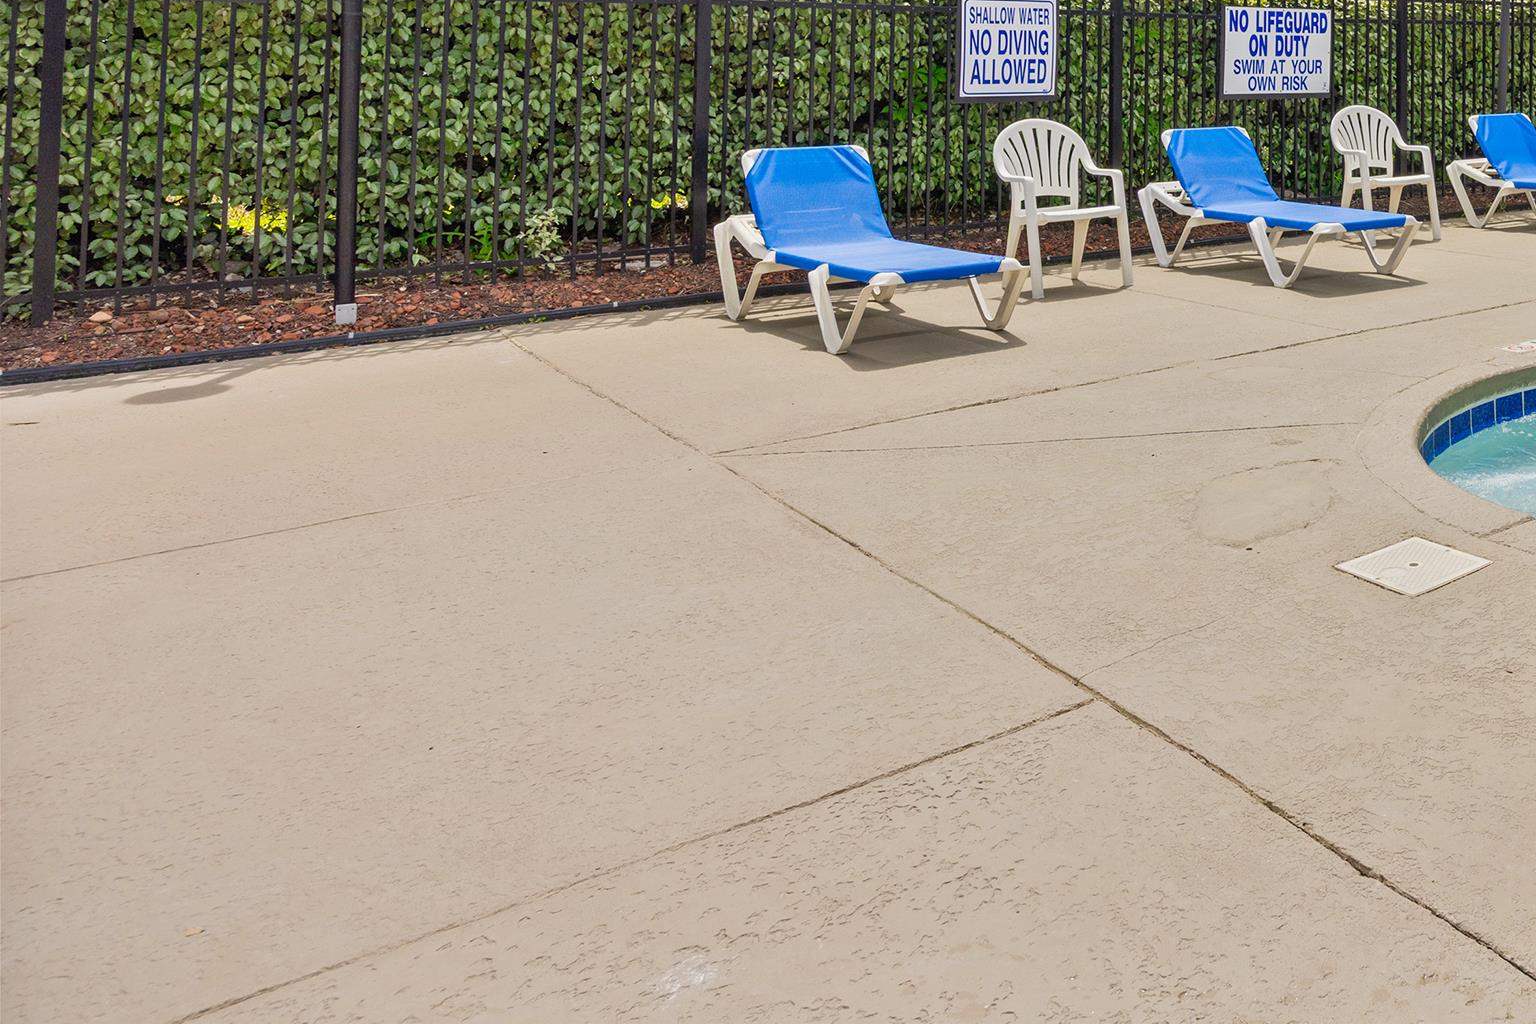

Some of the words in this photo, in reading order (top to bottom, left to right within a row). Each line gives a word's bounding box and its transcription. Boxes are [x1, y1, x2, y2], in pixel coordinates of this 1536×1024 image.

[969, 6, 1016, 24] SHALLOW
[1019, 7, 1050, 25] WATER
[1229, 9, 1249, 32] NO
[1256, 10, 1328, 34] LIFEGUARD
[969, 29, 992, 55] NO
[997, 29, 1049, 55] DIVING
[1248, 34, 1268, 57] ON
[1275, 34, 1310, 57] DUTY
[969, 58, 1047, 85] ALLOWED
[1233, 59, 1265, 75] SWIM
[1270, 59, 1286, 75] AT
[1291, 59, 1323, 75] YOUR
[1248, 75, 1276, 91] OWN
[1281, 75, 1308, 91] RISK
